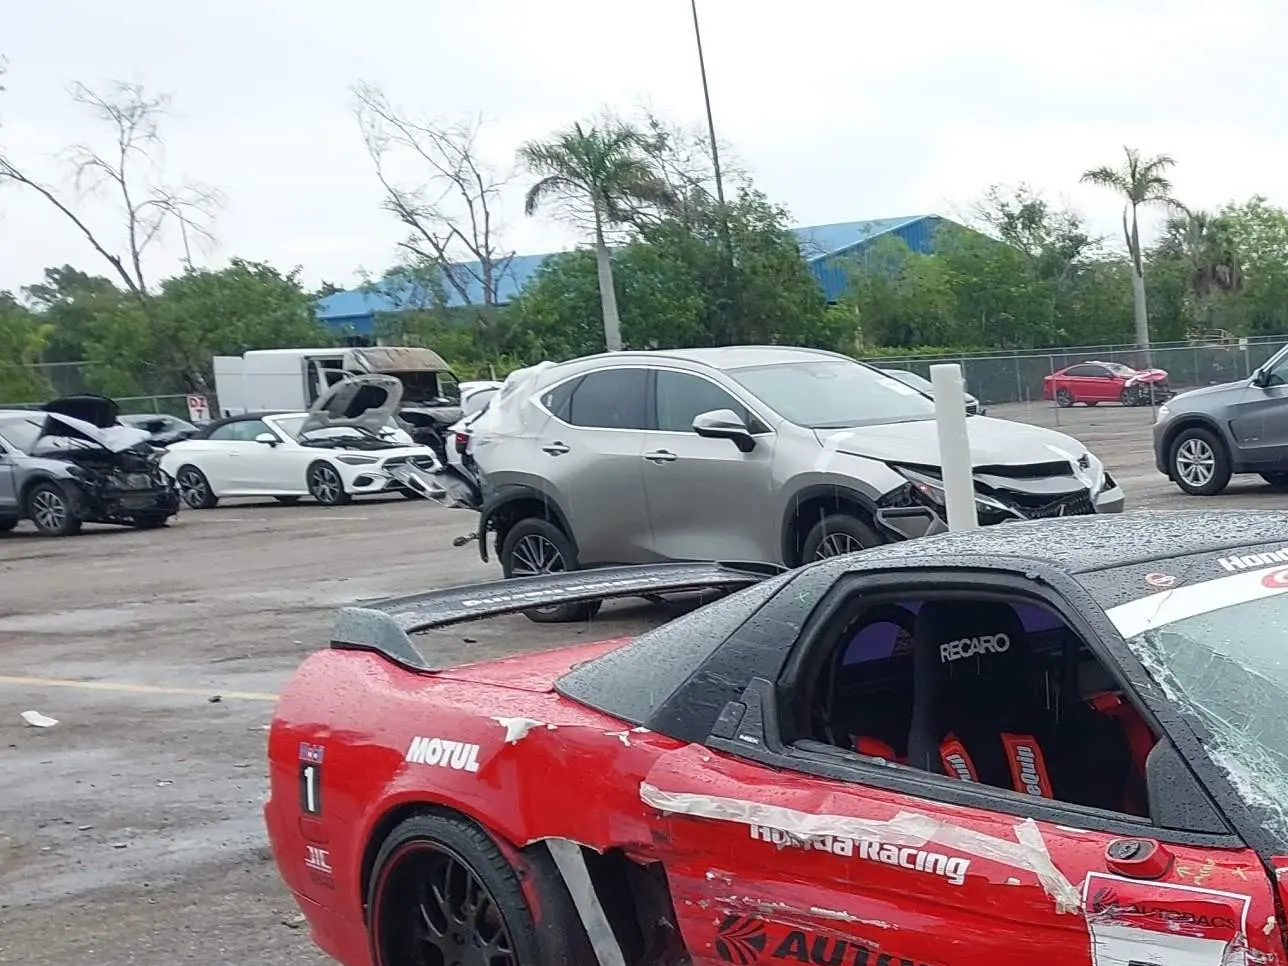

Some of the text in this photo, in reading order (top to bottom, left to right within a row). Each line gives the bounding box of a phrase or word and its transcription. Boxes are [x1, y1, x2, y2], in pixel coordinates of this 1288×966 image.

[939, 633, 1011, 663] RECARO
[406, 736, 480, 772] MOTUL
[303, 766, 315, 813] 1
[858, 836, 972, 885] Racing
